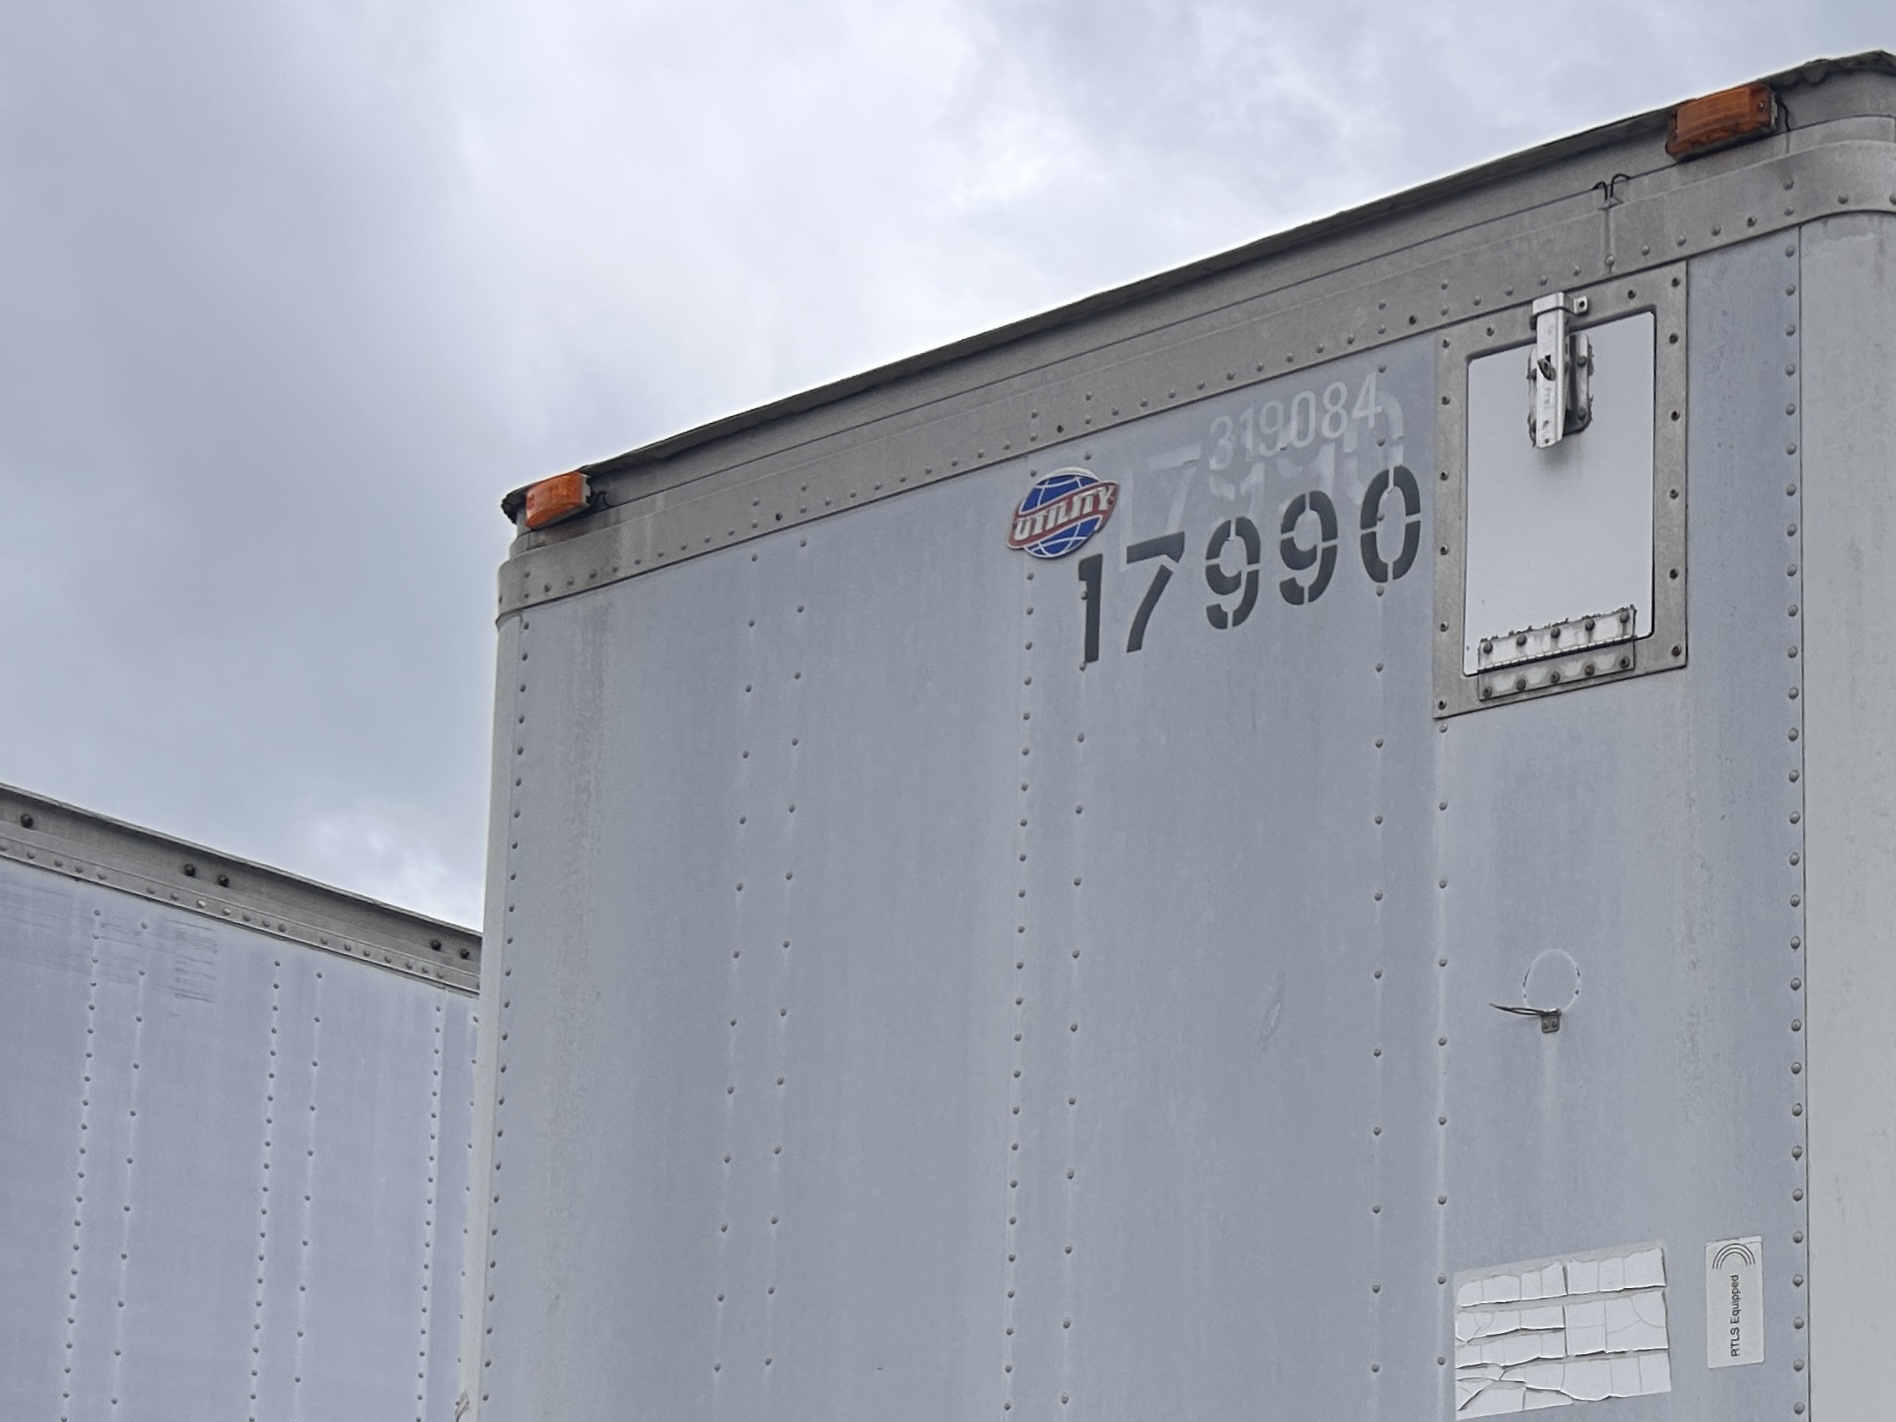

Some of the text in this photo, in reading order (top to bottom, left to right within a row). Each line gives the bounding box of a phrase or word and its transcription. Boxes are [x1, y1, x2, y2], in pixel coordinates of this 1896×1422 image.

[1208, 371, 1383, 471] 319084
[1014, 485, 1116, 542] UTILITY
[1078, 464, 1422, 664] 17990
[1729, 1274, 1742, 1357] RTLS Equipped
